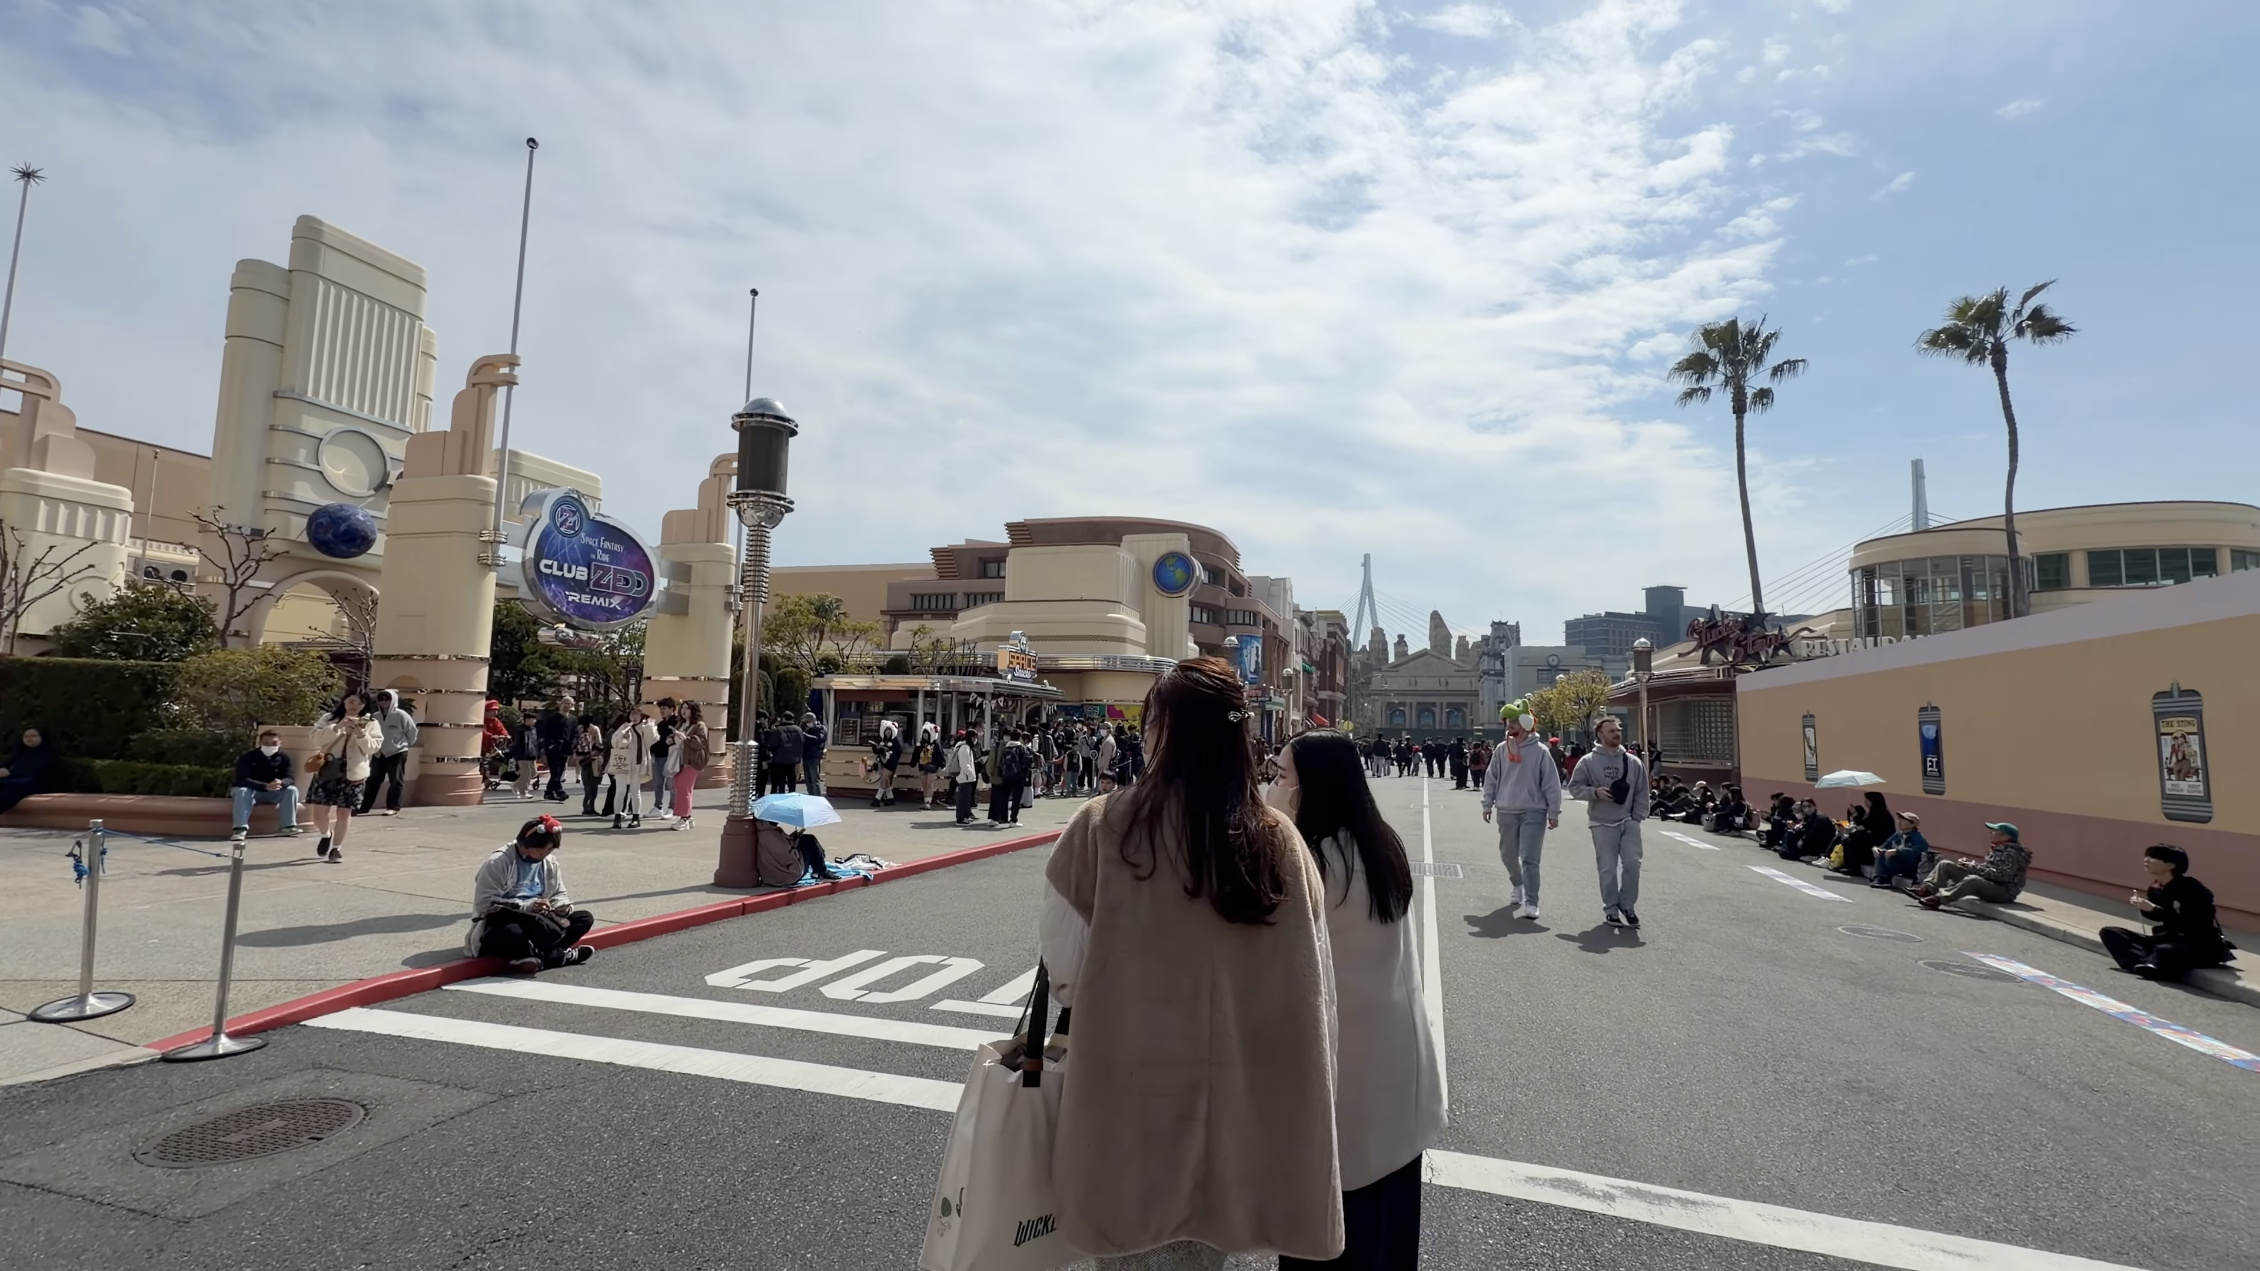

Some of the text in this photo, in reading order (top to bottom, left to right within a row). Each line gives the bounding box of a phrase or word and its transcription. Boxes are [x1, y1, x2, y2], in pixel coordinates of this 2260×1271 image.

[539, 559, 588, 581] CLUB
[565, 591, 622, 610] REMIX
[1009, 652, 1036, 672] SPACE
[2161, 718, 2197, 729] THE STING
